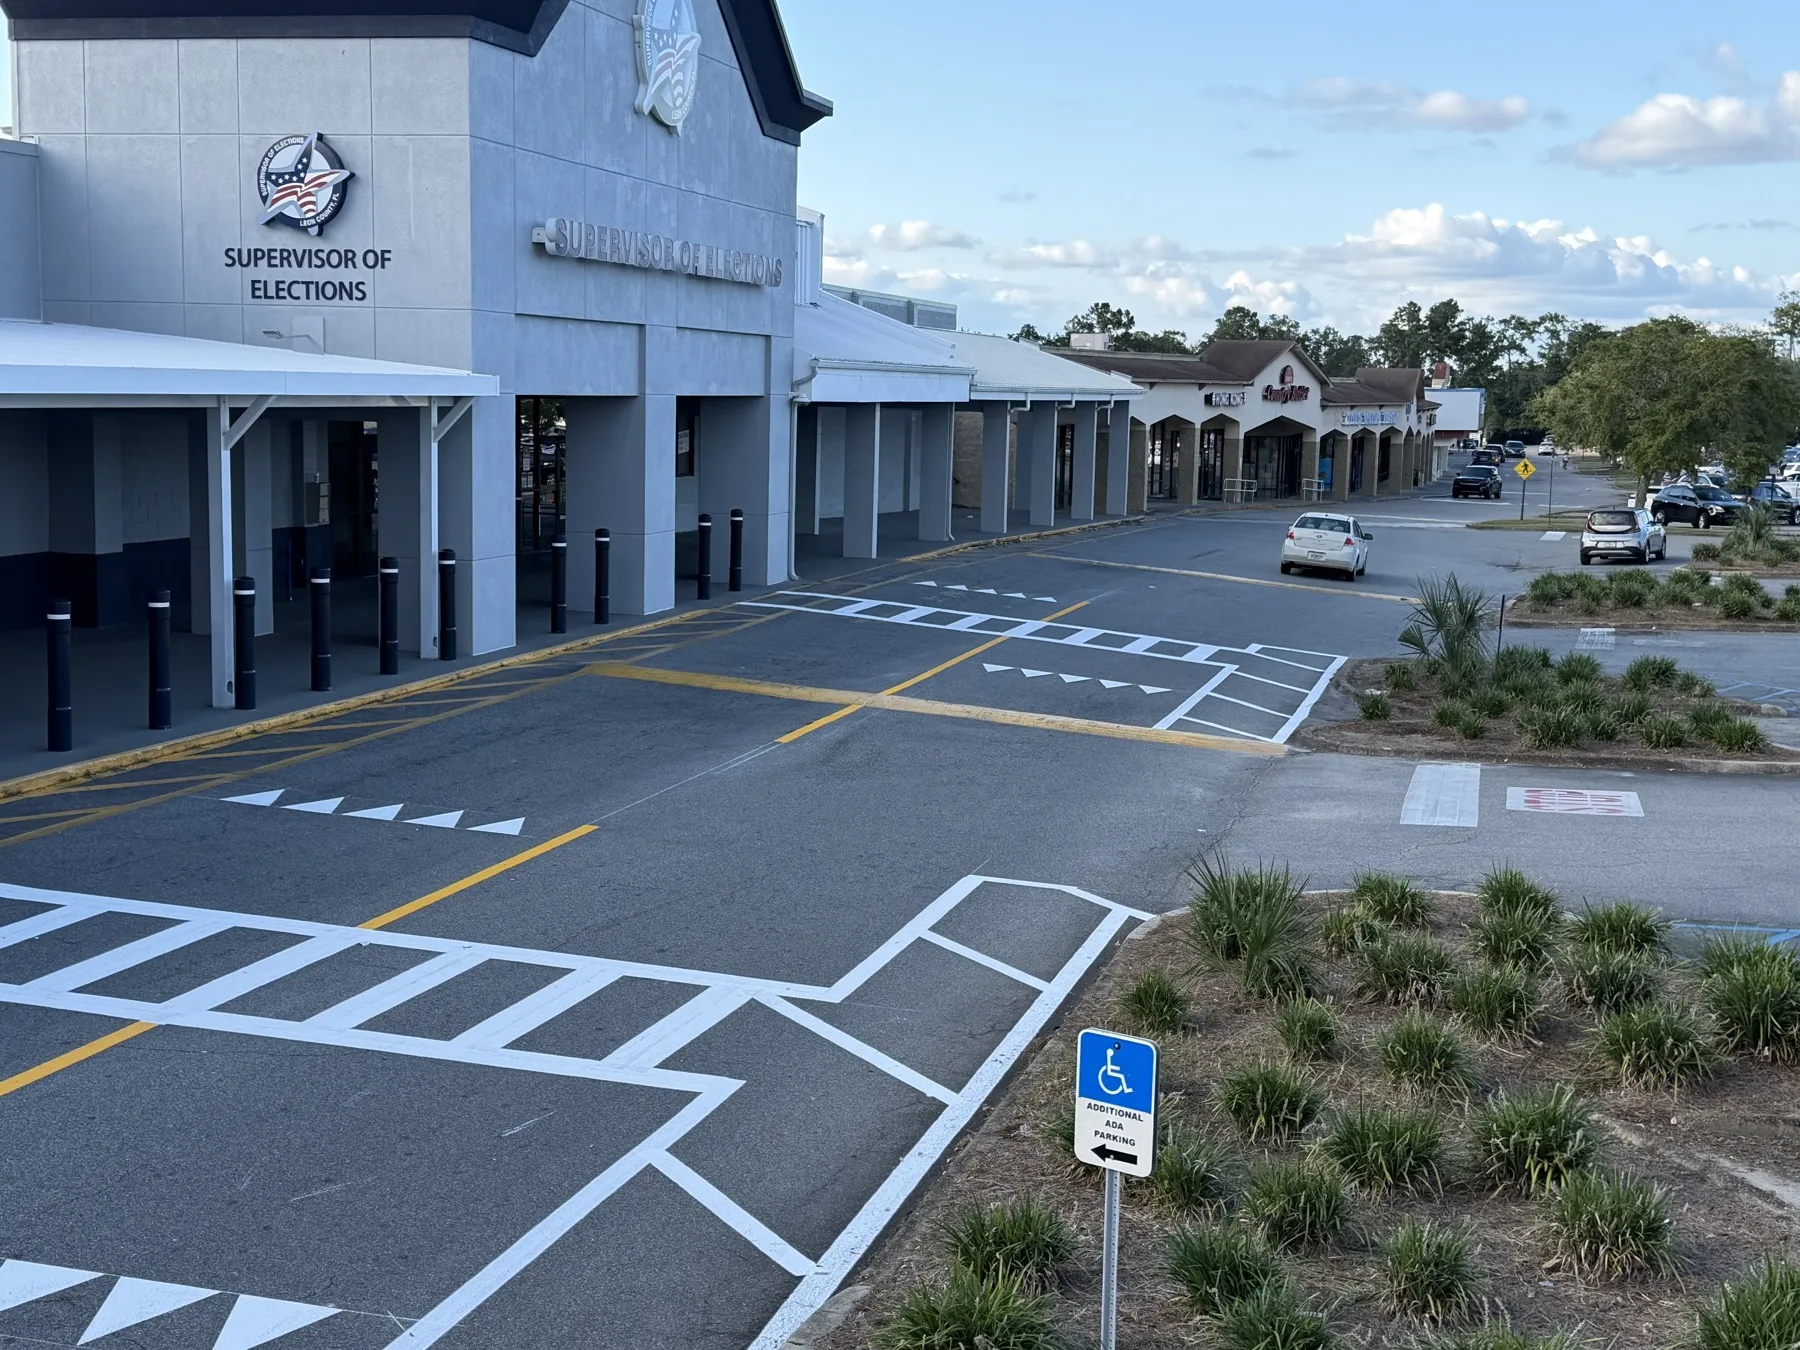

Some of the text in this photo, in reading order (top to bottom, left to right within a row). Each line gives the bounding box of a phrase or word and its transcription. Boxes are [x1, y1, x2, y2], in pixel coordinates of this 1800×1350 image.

[261, 137, 305, 197] SUPERVISOR OF ELECTIONS
[299, 217, 316, 227] LEON
[332, 192, 340, 201] FL
[224, 247, 392, 270] SUPERVISOR OF
[550, 218, 782, 287] SUPERVISOR OF ELECTIONS
[250, 279, 367, 302] ELECTIONS
[1086, 1102, 1144, 1122] ADDITIONAL
[1105, 1119, 1124, 1131] ADA
[1094, 1130, 1136, 1147] PARKING
